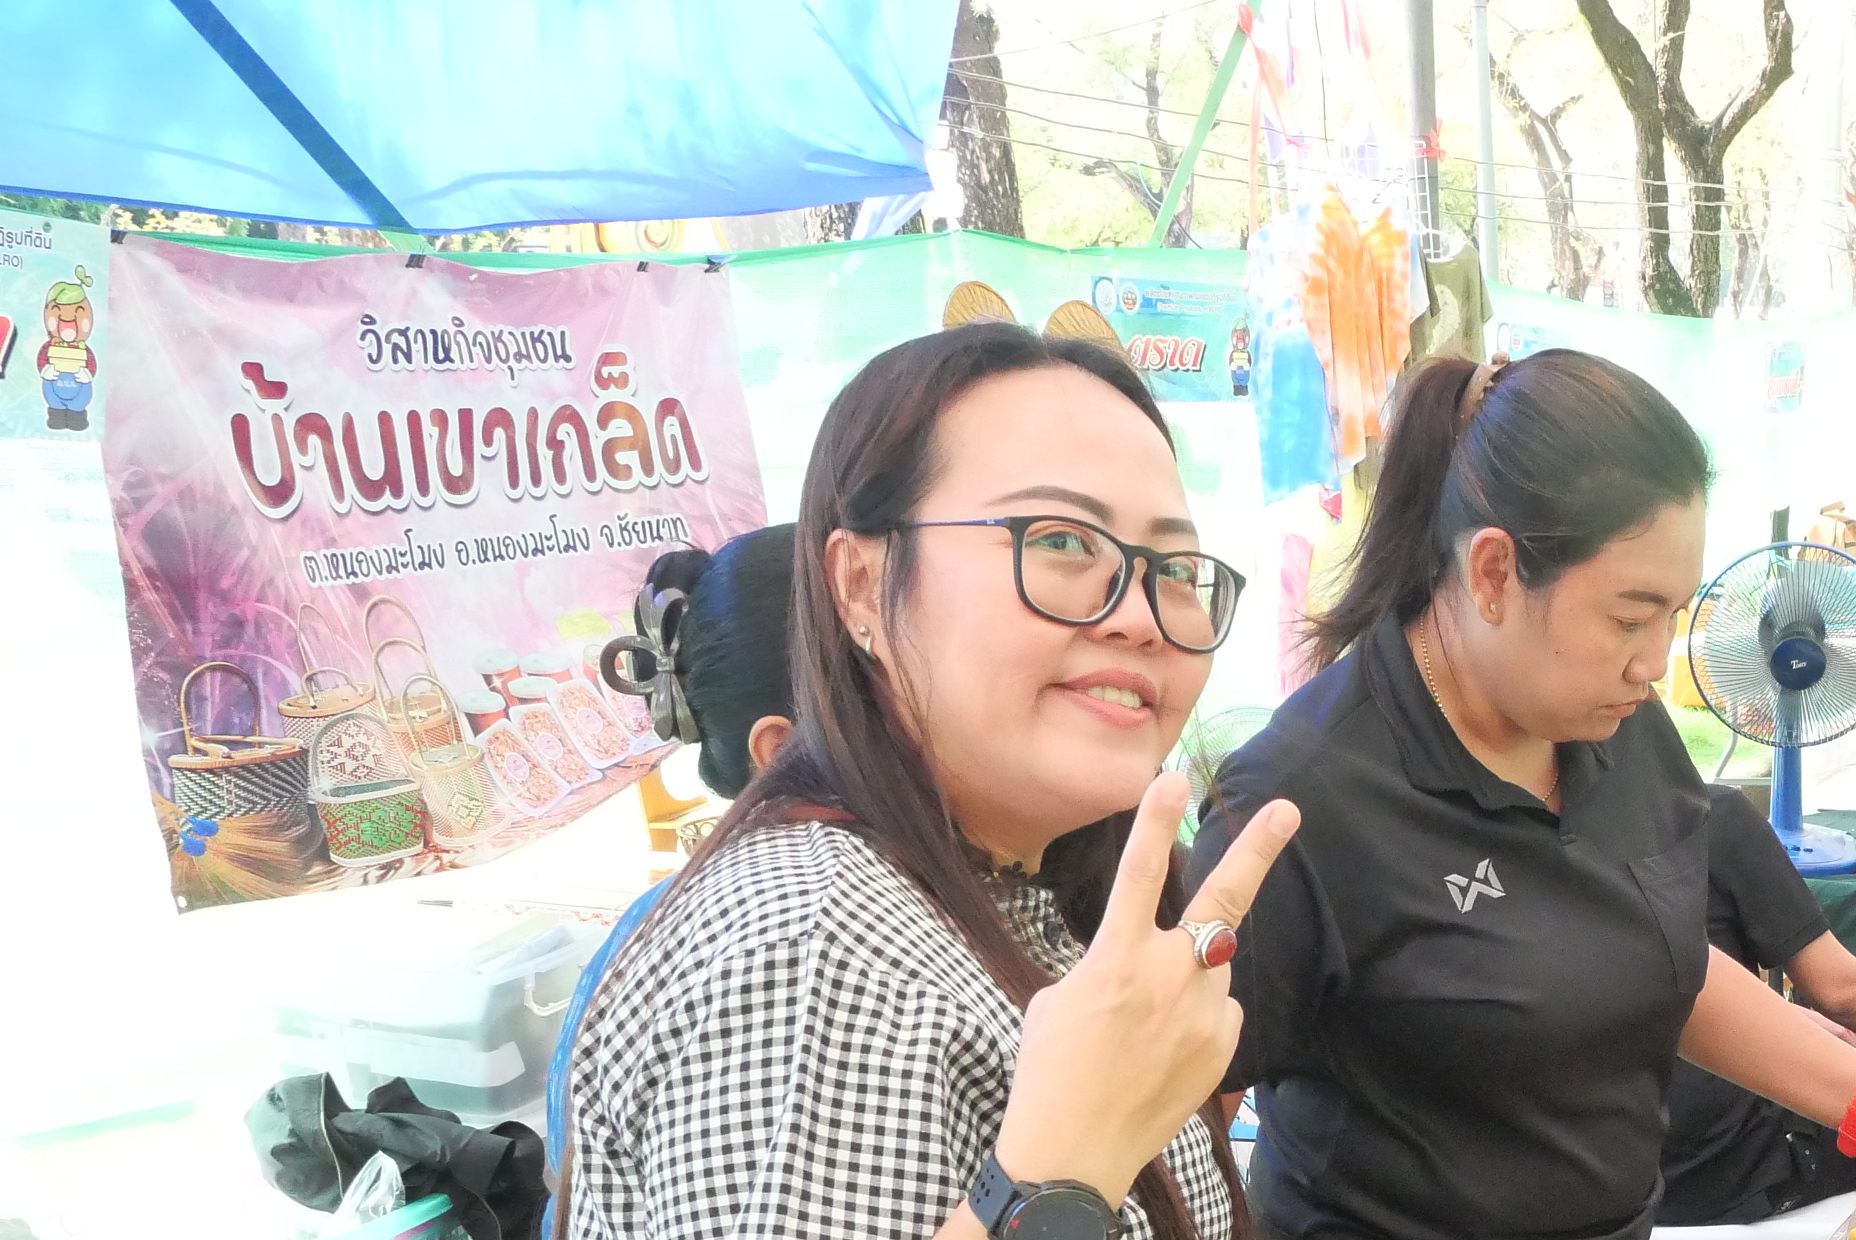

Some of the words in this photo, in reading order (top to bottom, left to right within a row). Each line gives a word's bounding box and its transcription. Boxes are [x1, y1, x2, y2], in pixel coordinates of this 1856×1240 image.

[361, 314, 572, 384] วิสาหกิจชุมชน
[1125, 334, 1205, 372] ตราด
[231, 353, 701, 507] บ้านเขาเกล็ด
[303, 527, 446, 585] ต.หนองมะโมง
[456, 513, 591, 568] อ.หนองมะโมง
[599, 512, 690, 551] จ.ชัยนาท
